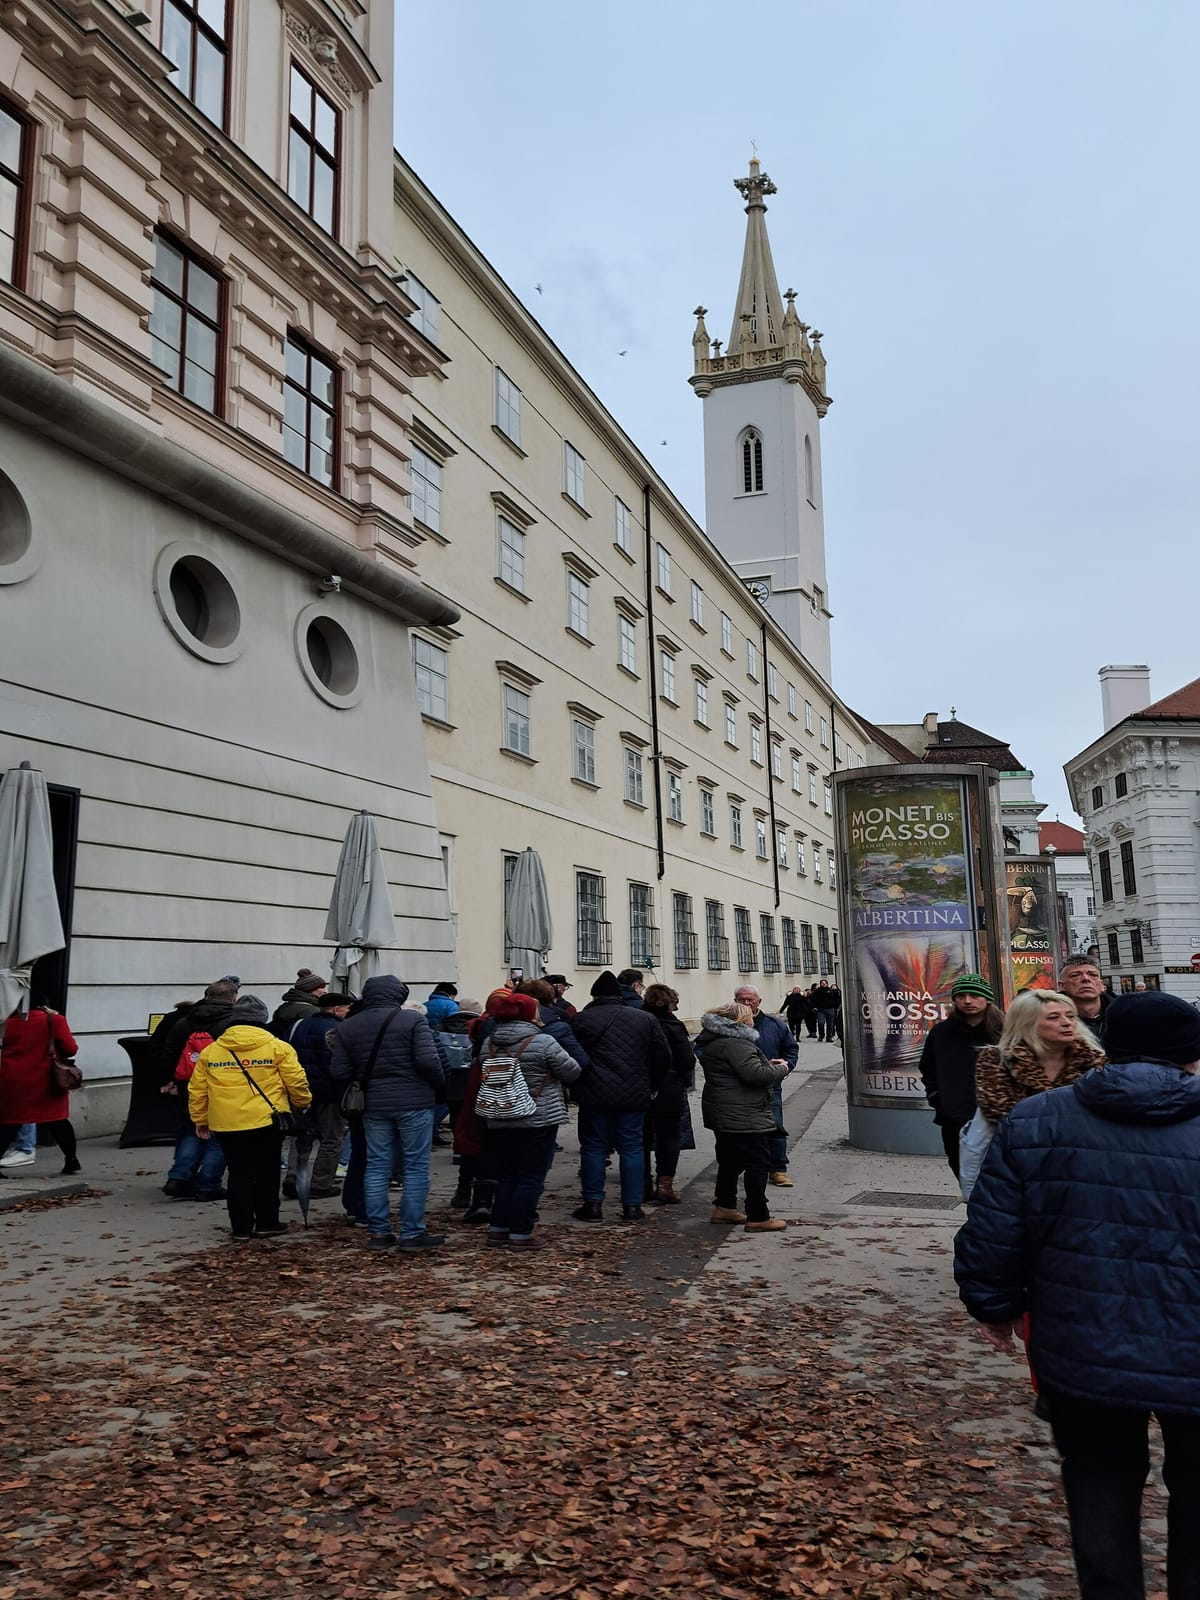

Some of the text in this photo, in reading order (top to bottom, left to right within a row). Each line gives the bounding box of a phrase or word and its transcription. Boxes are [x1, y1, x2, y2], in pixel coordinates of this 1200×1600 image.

[852, 805, 954, 827] MONET BIS
[852, 823, 951, 844] PICASSO
[1006, 863, 1046, 873] BERTIN
[855, 909, 964, 926] ALBERTINA
[861, 991, 933, 1001] KATHARINA
[865, 1075, 923, 1092] ALBER
